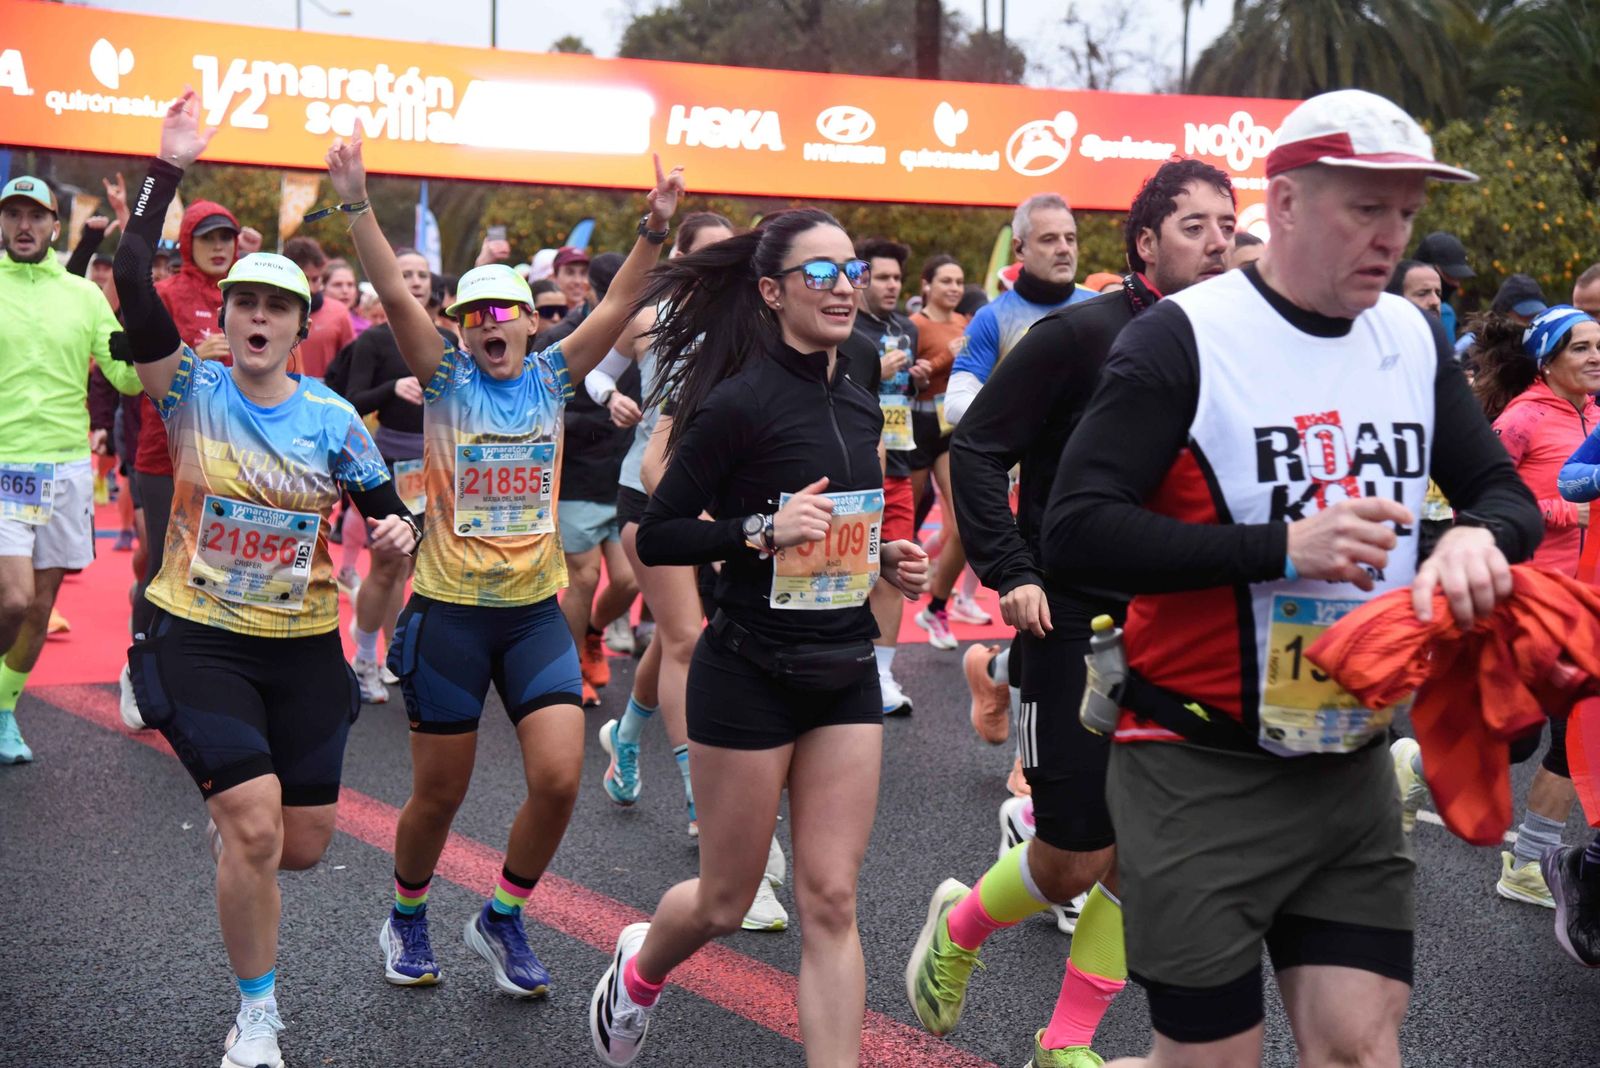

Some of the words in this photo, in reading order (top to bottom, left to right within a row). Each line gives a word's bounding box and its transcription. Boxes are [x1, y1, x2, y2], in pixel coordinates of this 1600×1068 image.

[250, 59, 455, 109] maratón
[666, 104, 786, 151] HOKA
[134, 176, 156, 217] KIPRUN
[254, 260, 285, 271] KIPRUN
[469, 275, 497, 286] KIPRUN
[1253, 422, 1425, 483] ROAD
[0, 474, 37, 496] 665
[464, 466, 542, 495] 21855
[207, 521, 298, 566] 21856
